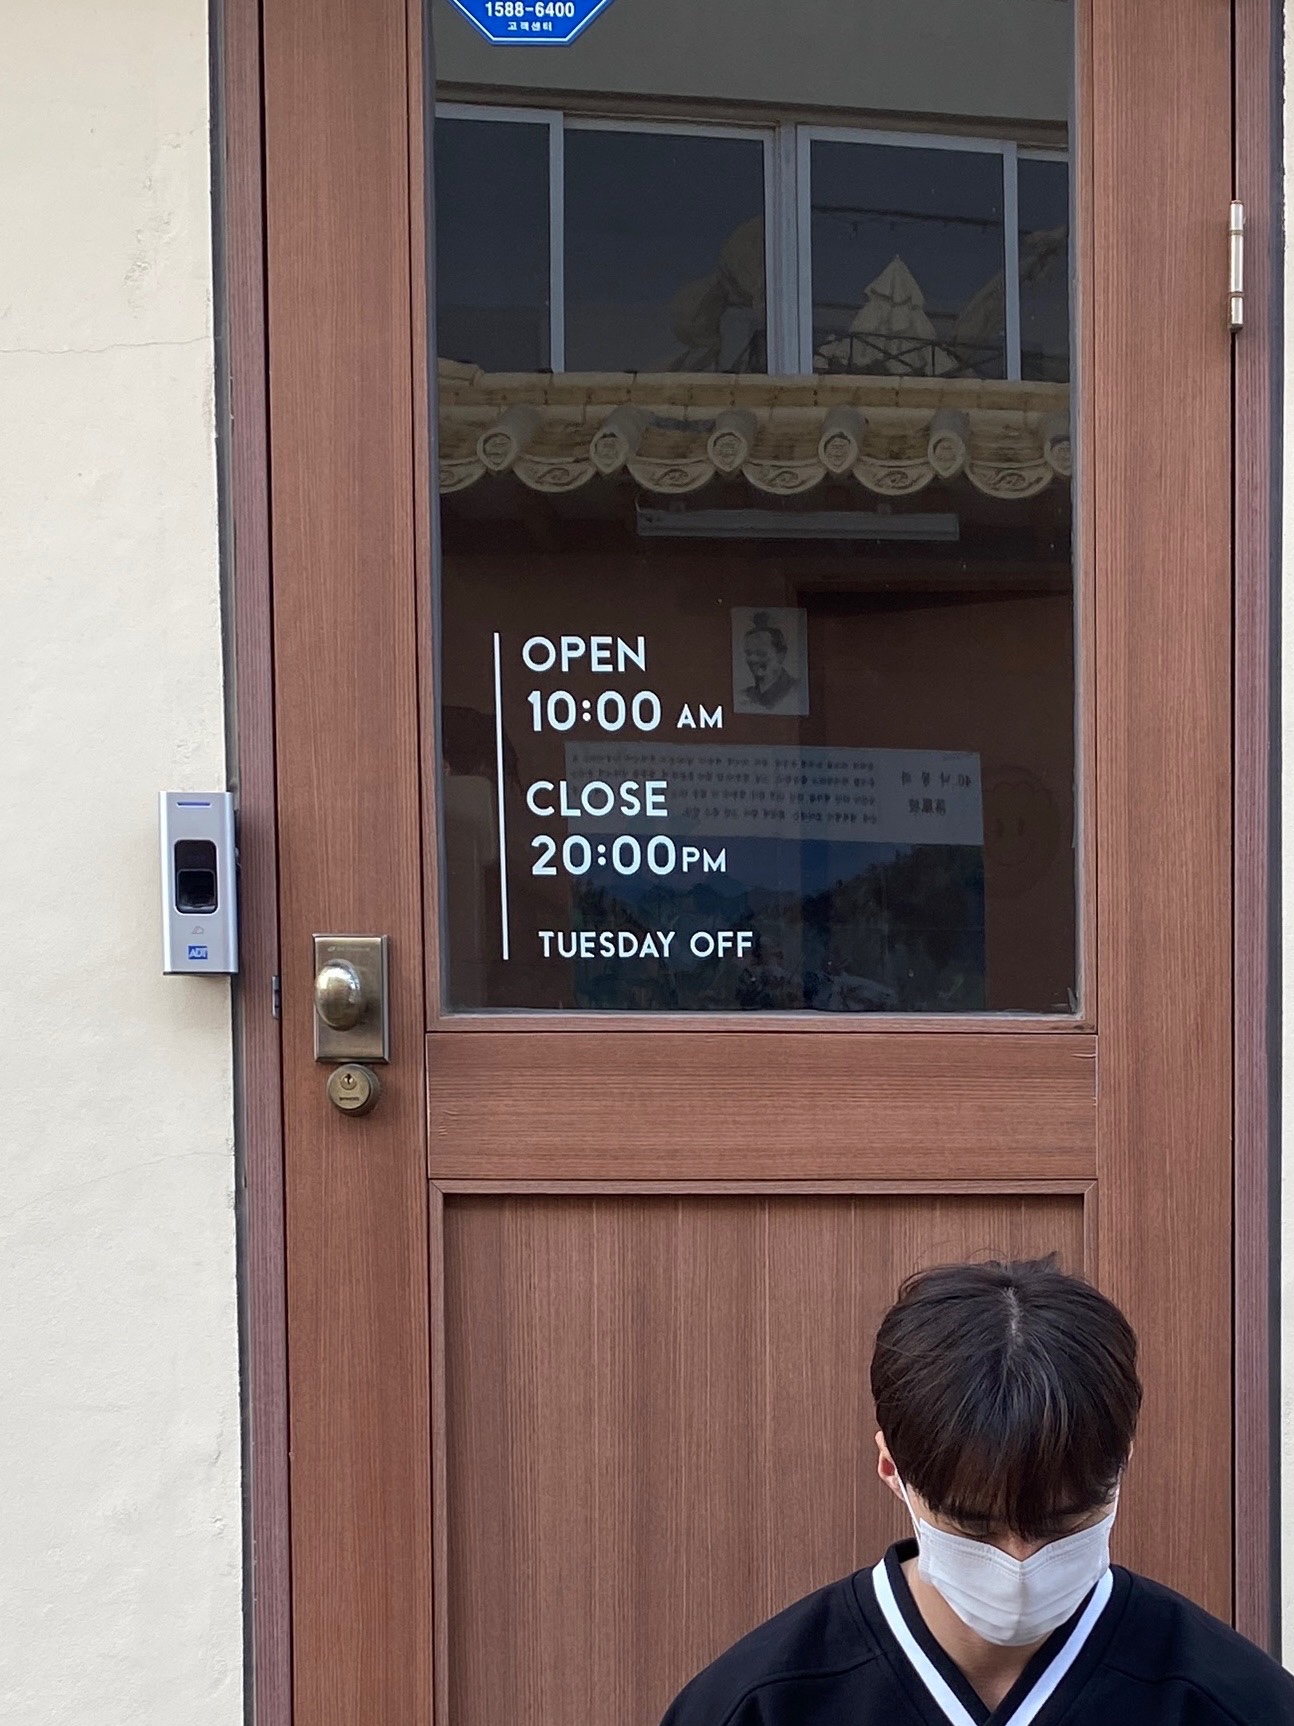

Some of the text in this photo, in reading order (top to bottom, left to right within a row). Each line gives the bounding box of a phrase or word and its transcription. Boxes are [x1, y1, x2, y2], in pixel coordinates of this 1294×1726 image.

[485, 1, 575, 17] 1588-6400
[507, 21, 553, 31] 고객센터
[522, 635, 646, 672] OPEN
[527, 690, 723, 732] 10:00 AM
[526, 780, 668, 817] CLOSE
[189, 946, 208, 958] ADT
[538, 930, 753, 958] TUESDAY OFF
